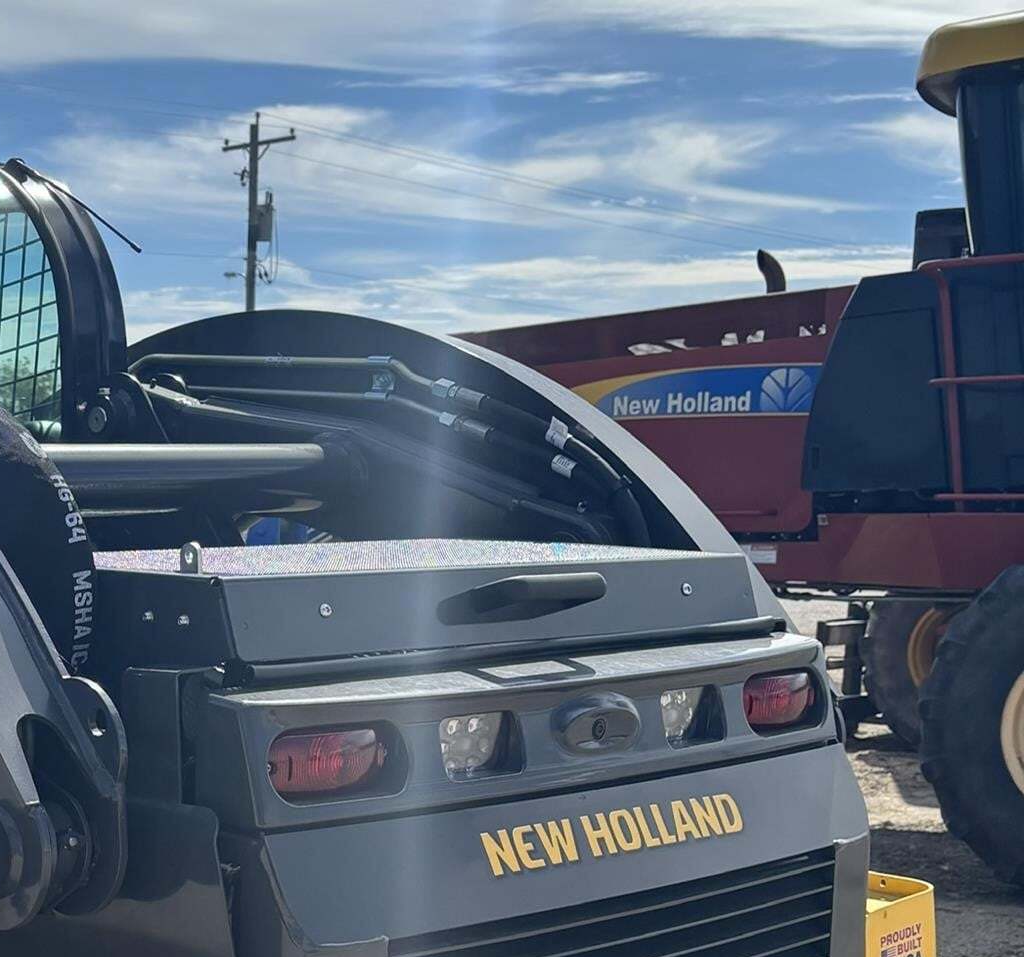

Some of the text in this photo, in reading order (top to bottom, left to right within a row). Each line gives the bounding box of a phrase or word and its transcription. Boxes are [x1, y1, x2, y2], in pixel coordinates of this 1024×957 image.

[613, 391, 751, 415] New Holland
[72, 569, 93, 640] MSHA
[480, 793, 743, 876] NEW HOLLAND
[880, 923, 921, 948] PROUDLY
[897, 936, 922, 955] BUILT
